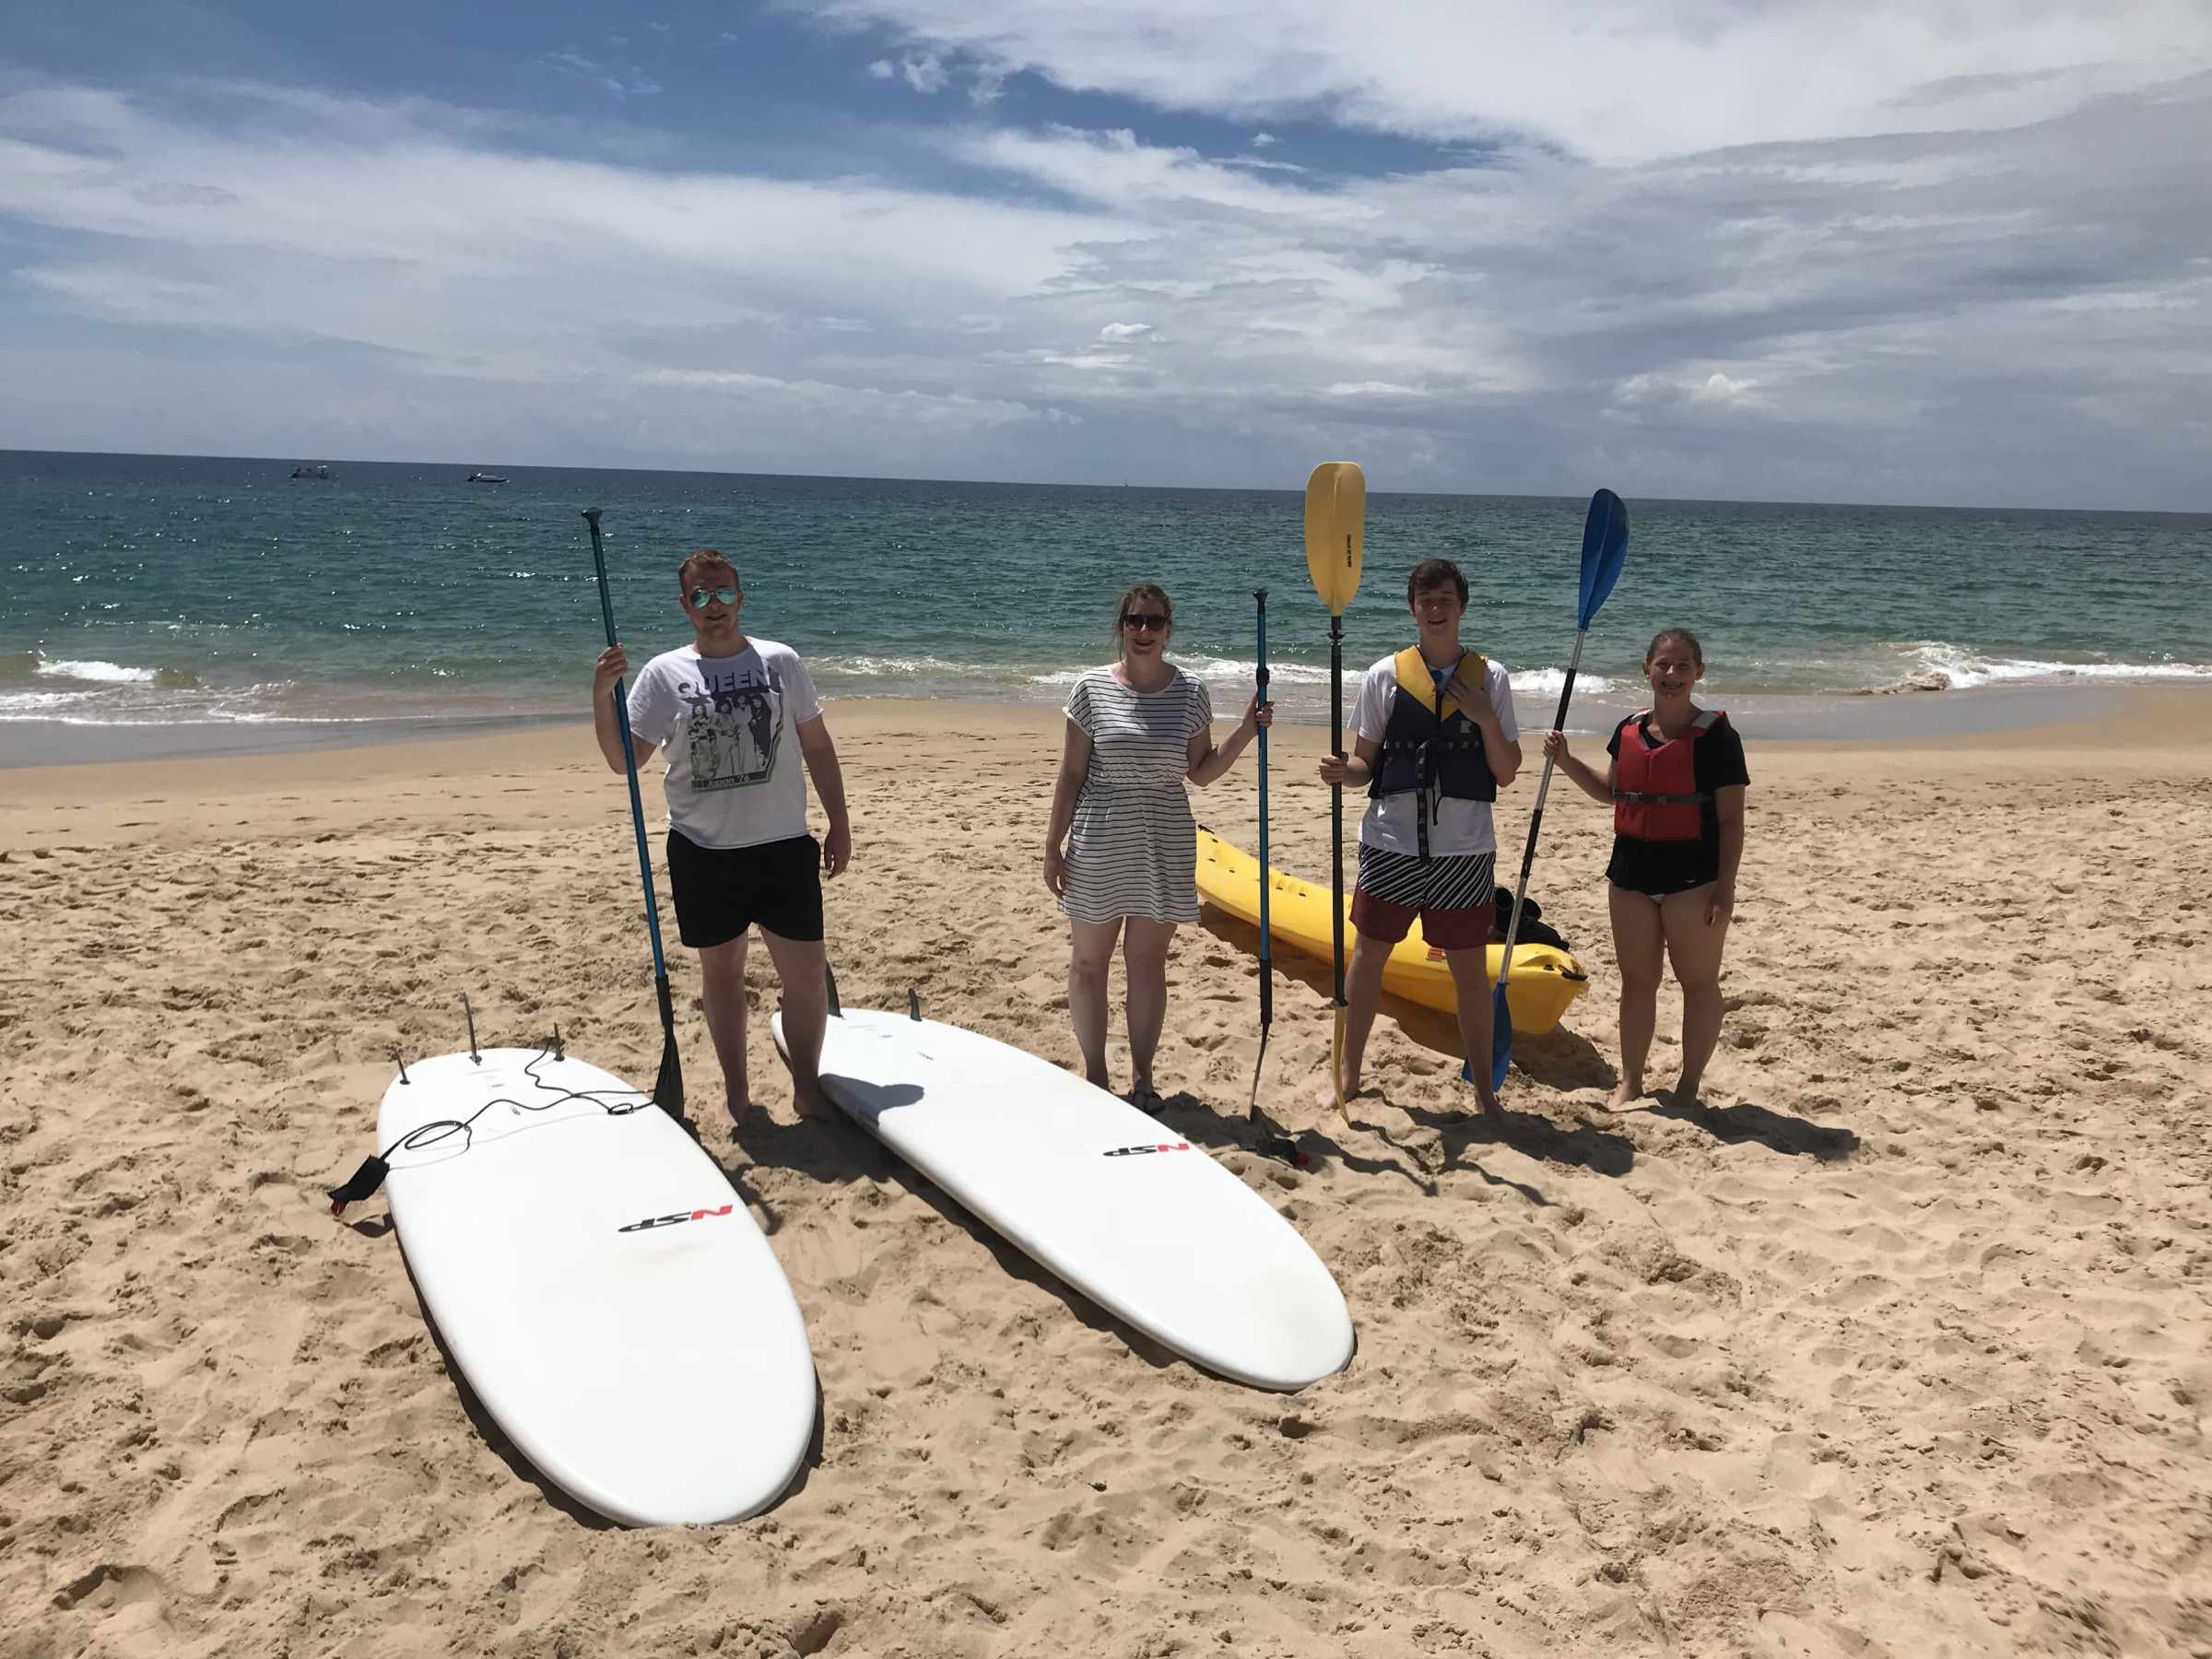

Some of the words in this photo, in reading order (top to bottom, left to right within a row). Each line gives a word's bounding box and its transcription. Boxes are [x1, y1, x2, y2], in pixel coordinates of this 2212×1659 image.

[677, 667, 781, 697] QUEEN
[1102, 1143, 1190, 1157] NSP
[618, 1205, 733, 1232] NSP
